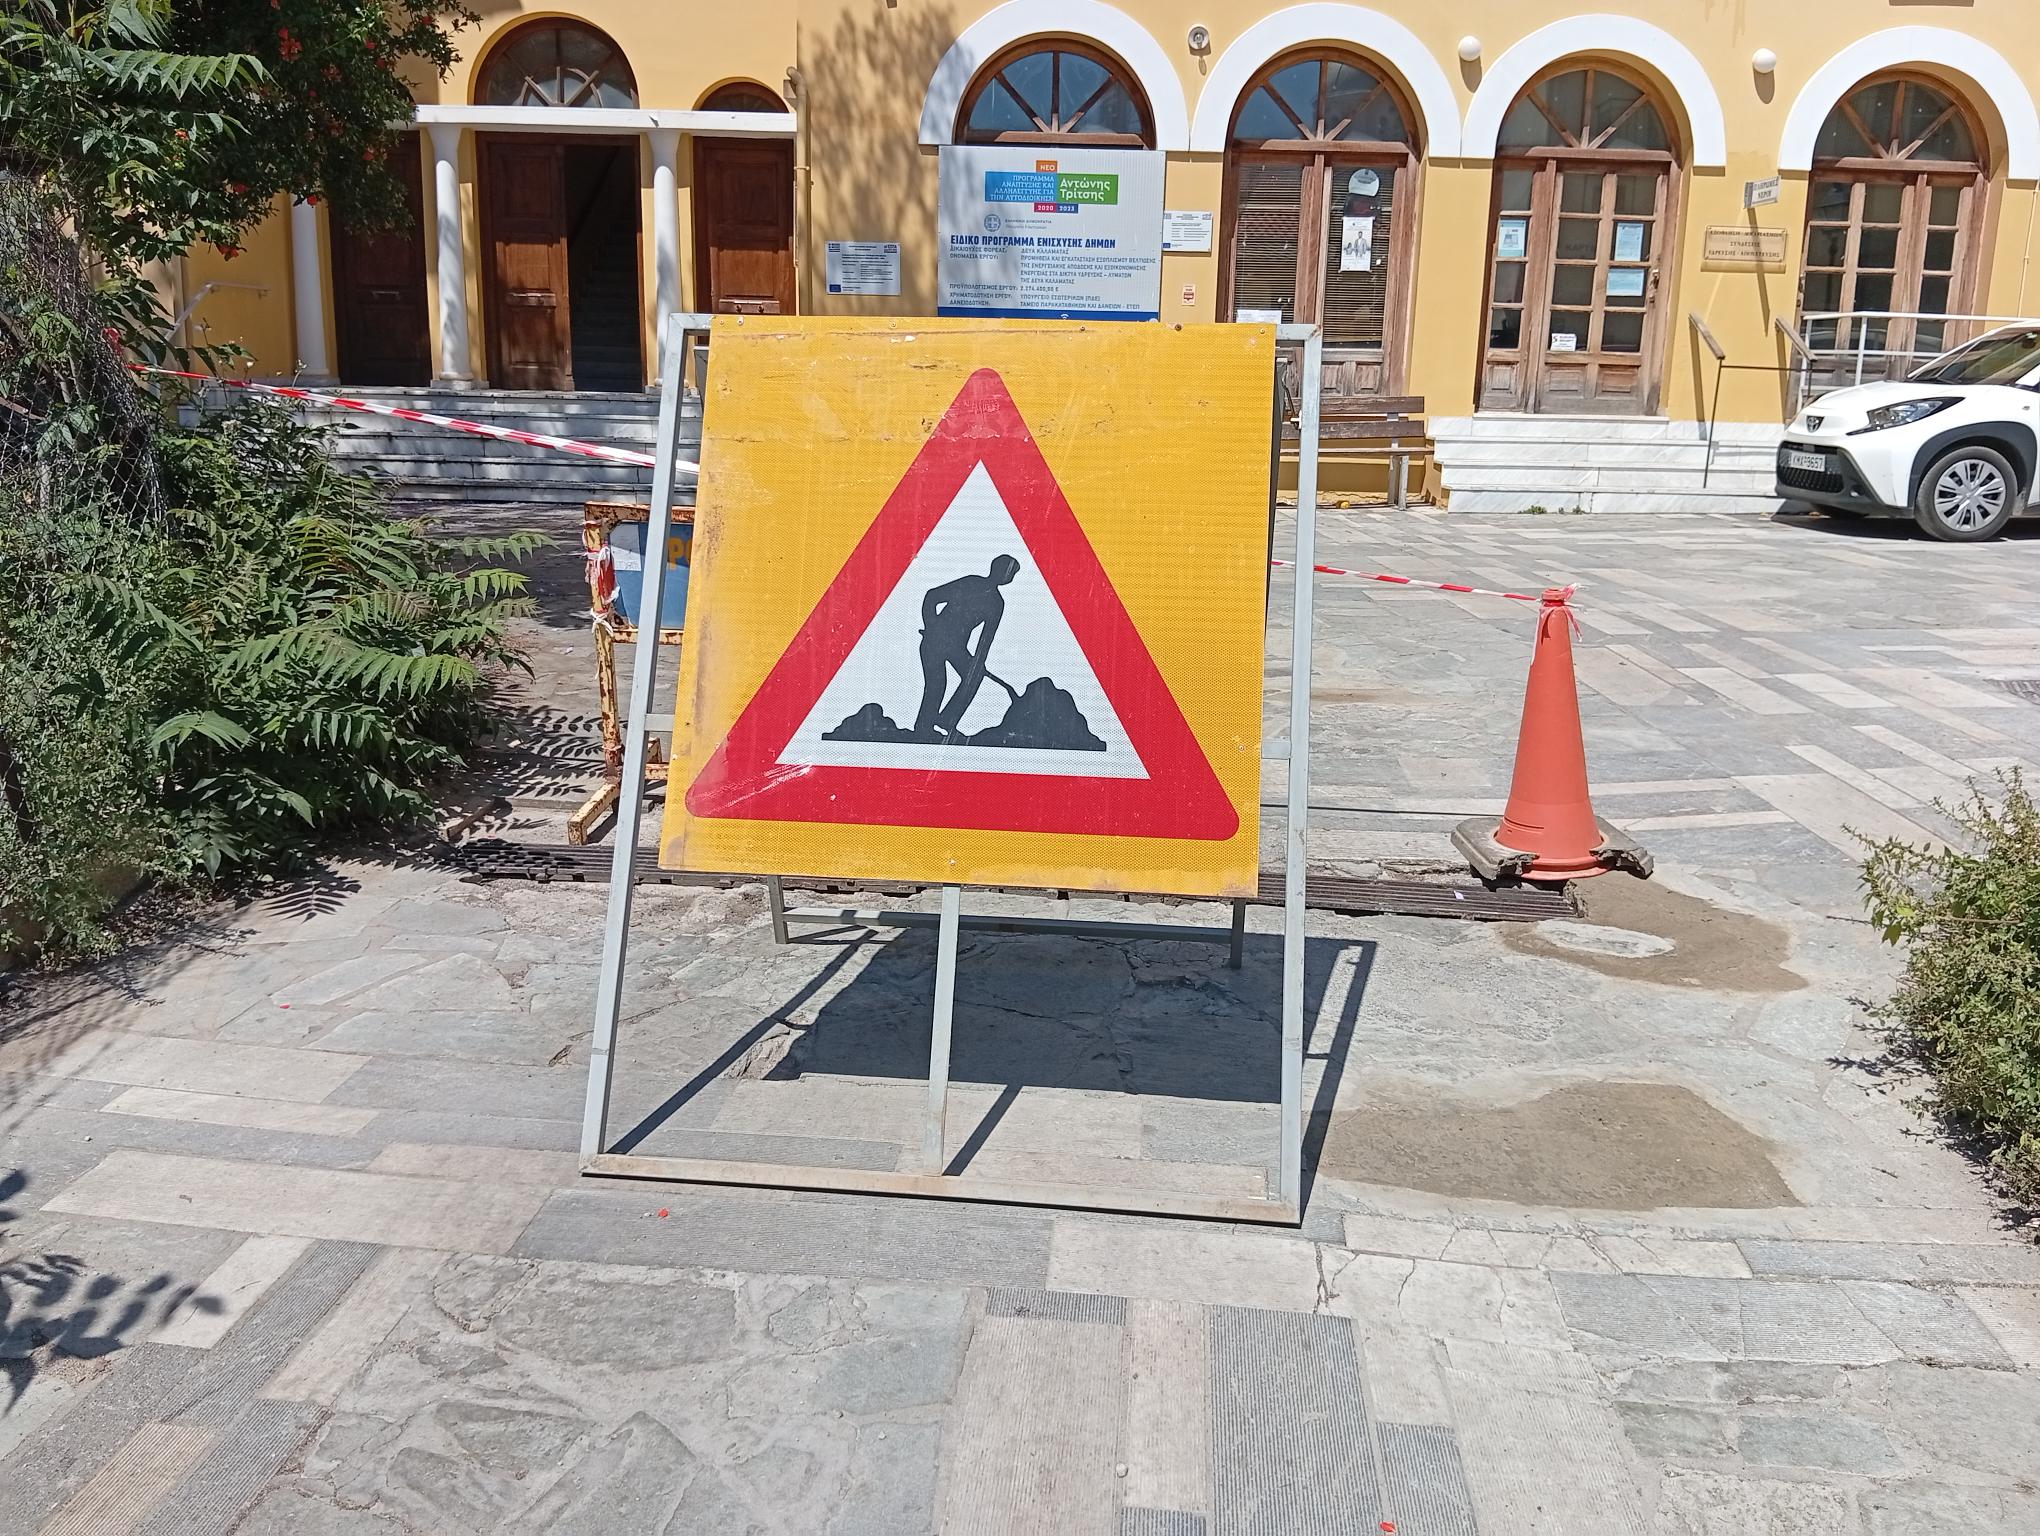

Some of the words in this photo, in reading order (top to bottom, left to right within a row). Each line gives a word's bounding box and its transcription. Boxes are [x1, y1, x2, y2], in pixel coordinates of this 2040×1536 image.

[1013, 175, 1055, 183] ΠΡΟΓΡΑΜΜΑ
[1059, 177, 1111, 191] Αντώνης
[1059, 187, 1105, 202] Τρίτσης
[950, 234, 980, 245] ΕΙΔΙΚΟ
[981, 235, 1035, 247] ΠΡΟΓΡΑΜΜΑ
[1037, 237, 1083, 248] ΕΝΙΣΧΥΣΗΣ
[1084, 238, 1116, 249] ΔΗΜΩΝ
